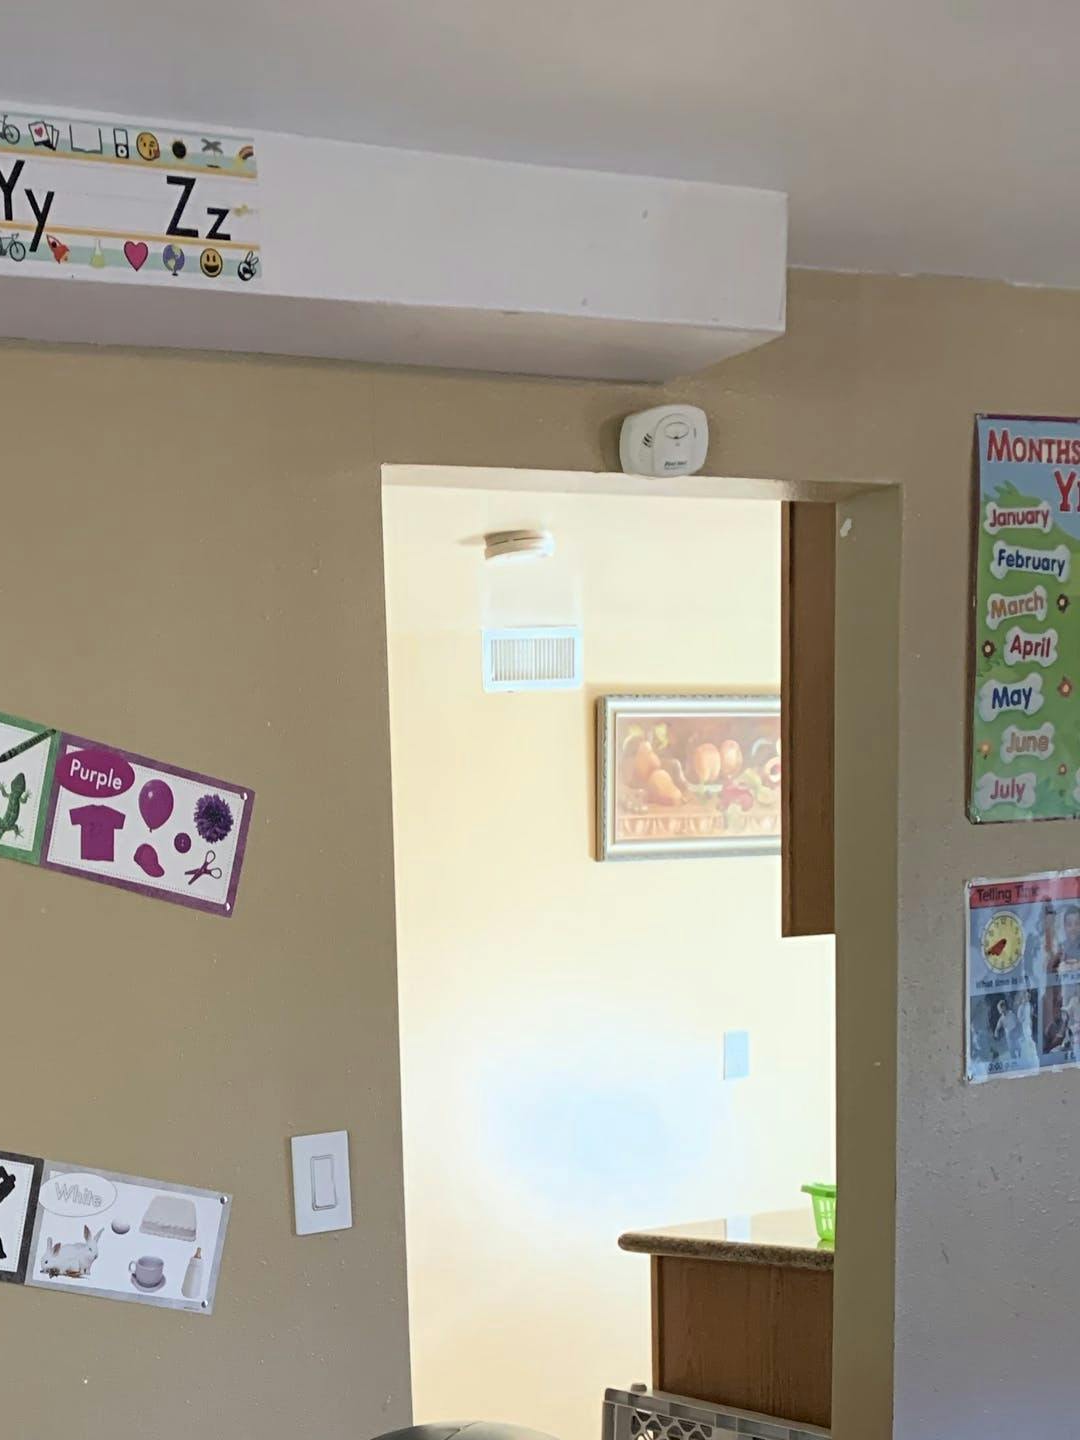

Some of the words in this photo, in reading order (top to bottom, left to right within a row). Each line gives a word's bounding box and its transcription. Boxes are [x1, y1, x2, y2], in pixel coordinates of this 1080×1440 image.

[164, 175, 232, 241] Zz
[989, 509, 1050, 528] January
[997, 548, 1066, 577] February
[991, 591, 1044, 619] March
[1010, 634, 1051, 660] April
[992, 686, 1033, 710] May
[1006, 732, 1049, 753] June
[70, 759, 122, 791] Purple
[990, 779, 1026, 803] July
[55, 1182, 101, 1207] White
